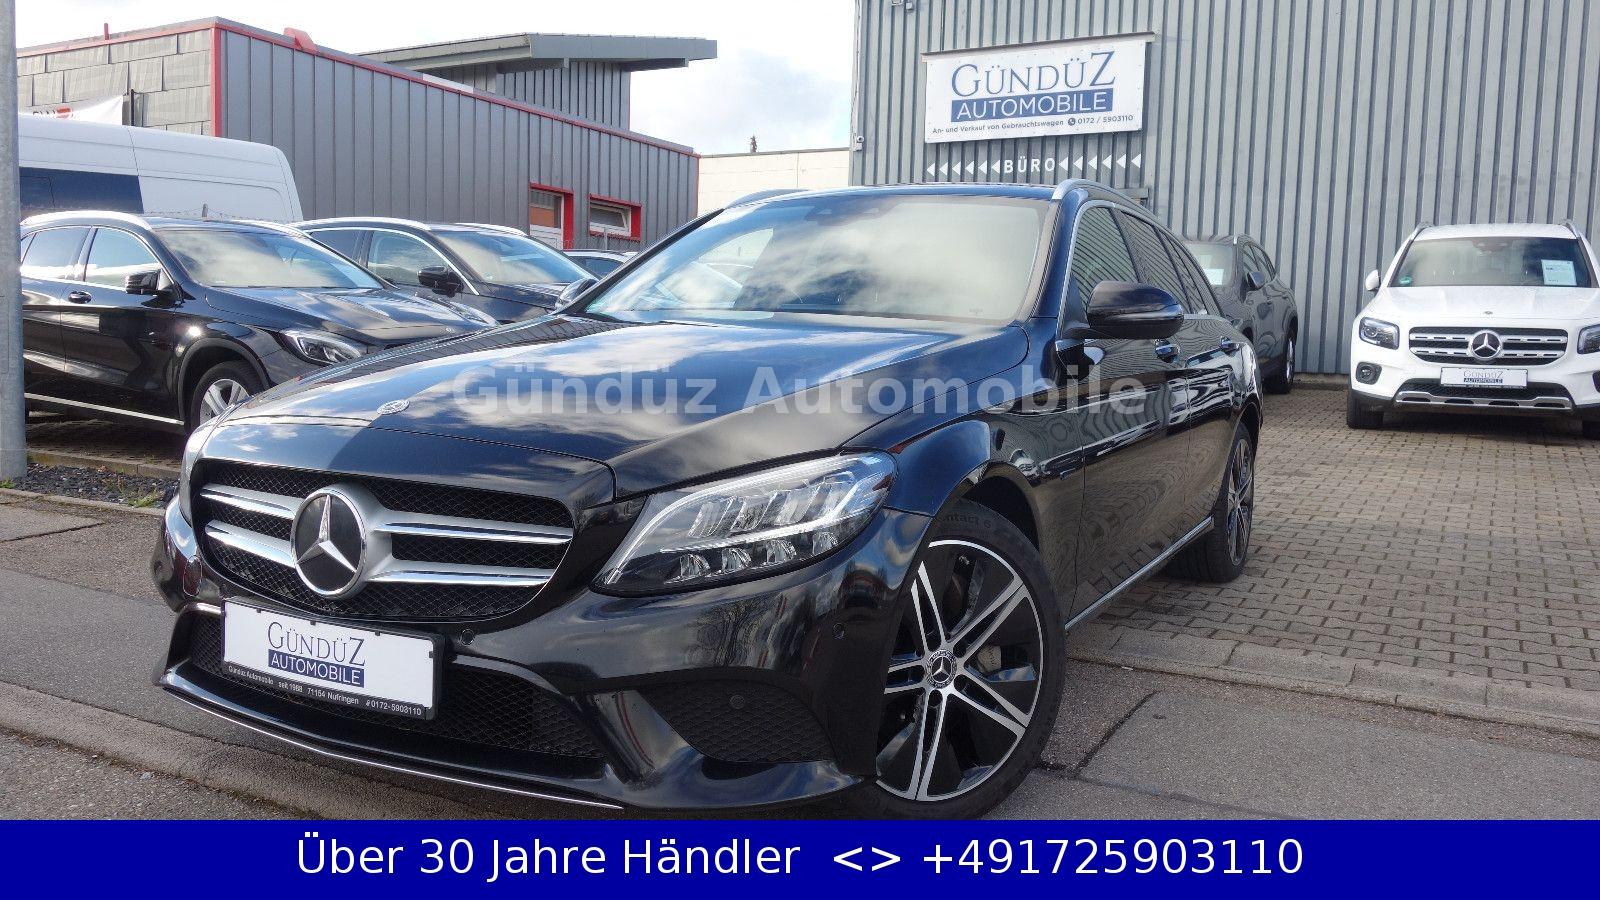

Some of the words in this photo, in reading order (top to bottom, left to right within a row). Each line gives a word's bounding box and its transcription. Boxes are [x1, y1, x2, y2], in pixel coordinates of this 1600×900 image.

[951, 50, 1116, 97] GÜNDÜZ
[956, 91, 1107, 120] AUTOMOBILE
[960, 123, 986, 132] Verkauf
[1001, 119, 1064, 130] Gebrauchtswagen
[1102, 115, 1134, 123] 5903110
[1003, 156, 1055, 174] BÜRO
[268, 621, 366, 666] GÜNDÜZ
[271, 652, 361, 685] AUTOMOBILE
[278, 681, 289, 690] seit
[327, 692, 359, 705] Nufringen
